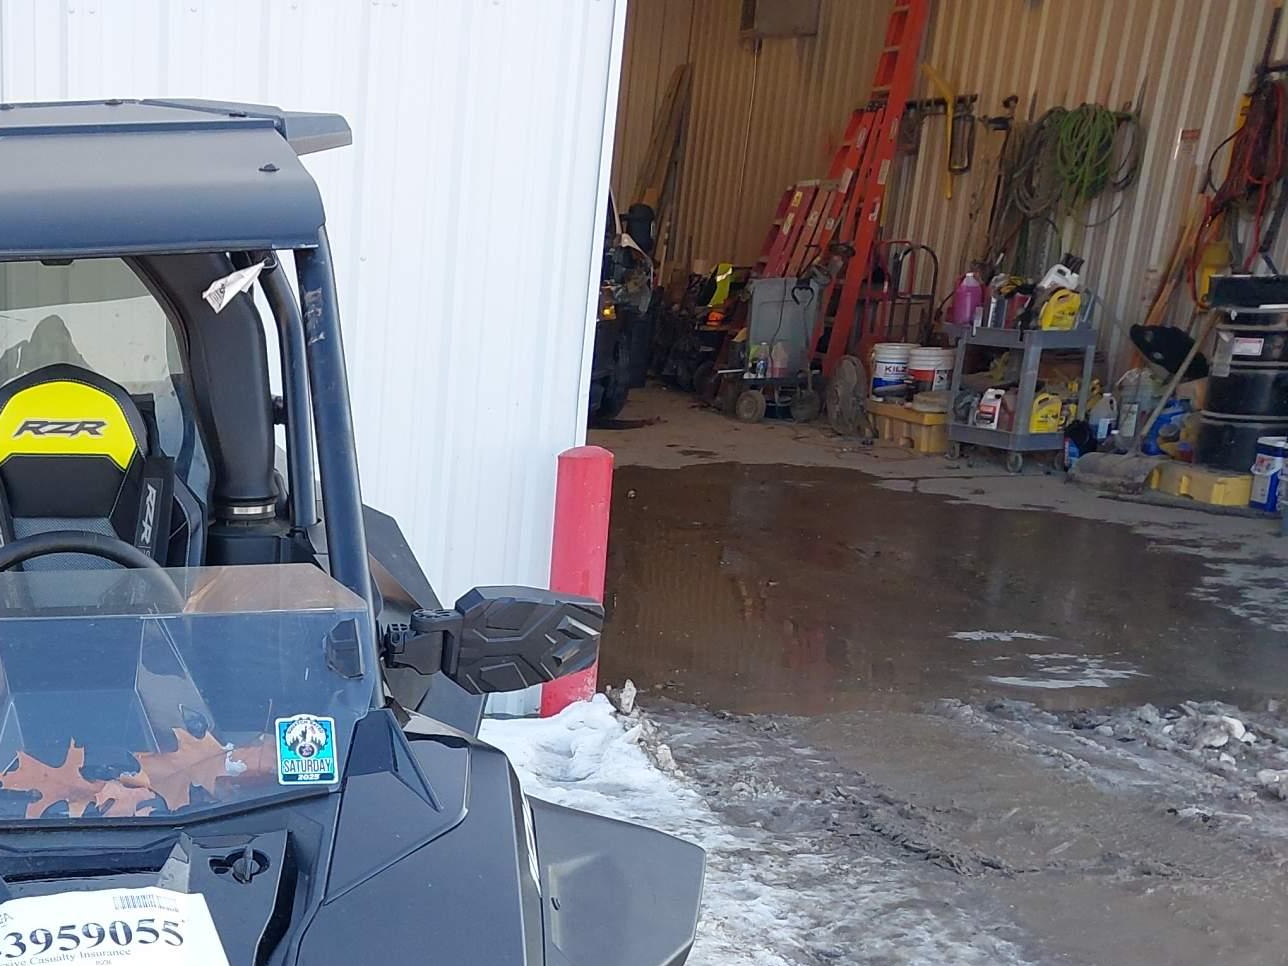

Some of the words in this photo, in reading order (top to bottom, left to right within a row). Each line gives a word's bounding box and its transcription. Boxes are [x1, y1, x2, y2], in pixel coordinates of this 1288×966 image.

[13, 420, 108, 438] RZR
[141, 483, 157, 545] RZR
[283, 759, 331, 773] SATURDAY
[29, 949, 75, 965] Casualty
[79, 948, 133, 960] Insurance
